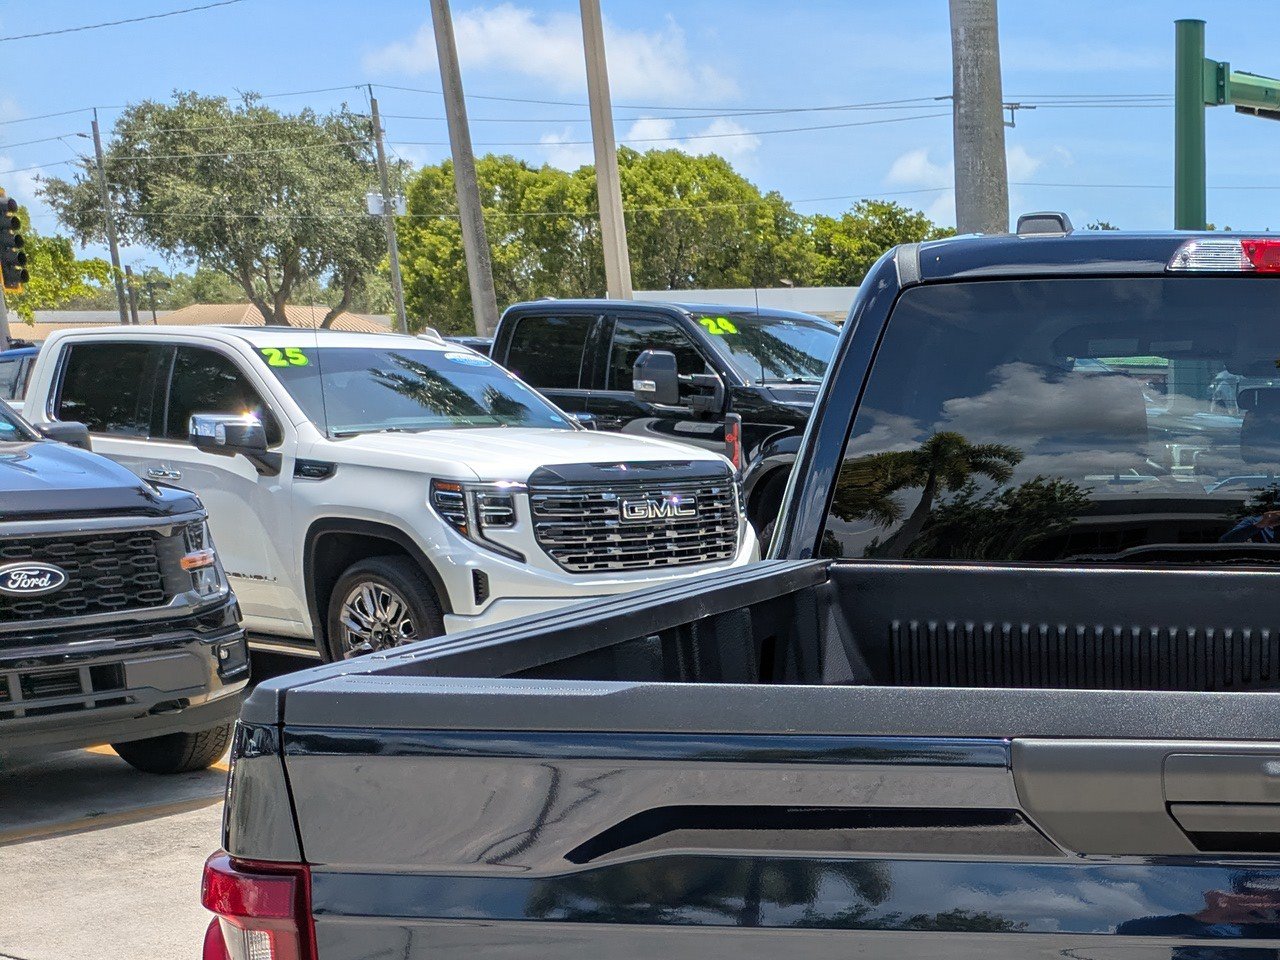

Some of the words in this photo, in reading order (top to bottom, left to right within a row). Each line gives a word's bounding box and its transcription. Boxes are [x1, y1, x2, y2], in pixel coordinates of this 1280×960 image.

[699, 317, 738, 335] 24
[261, 347, 308, 367] 25
[623, 497, 696, 519] GMC
[7, 570, 51, 589] Ford
